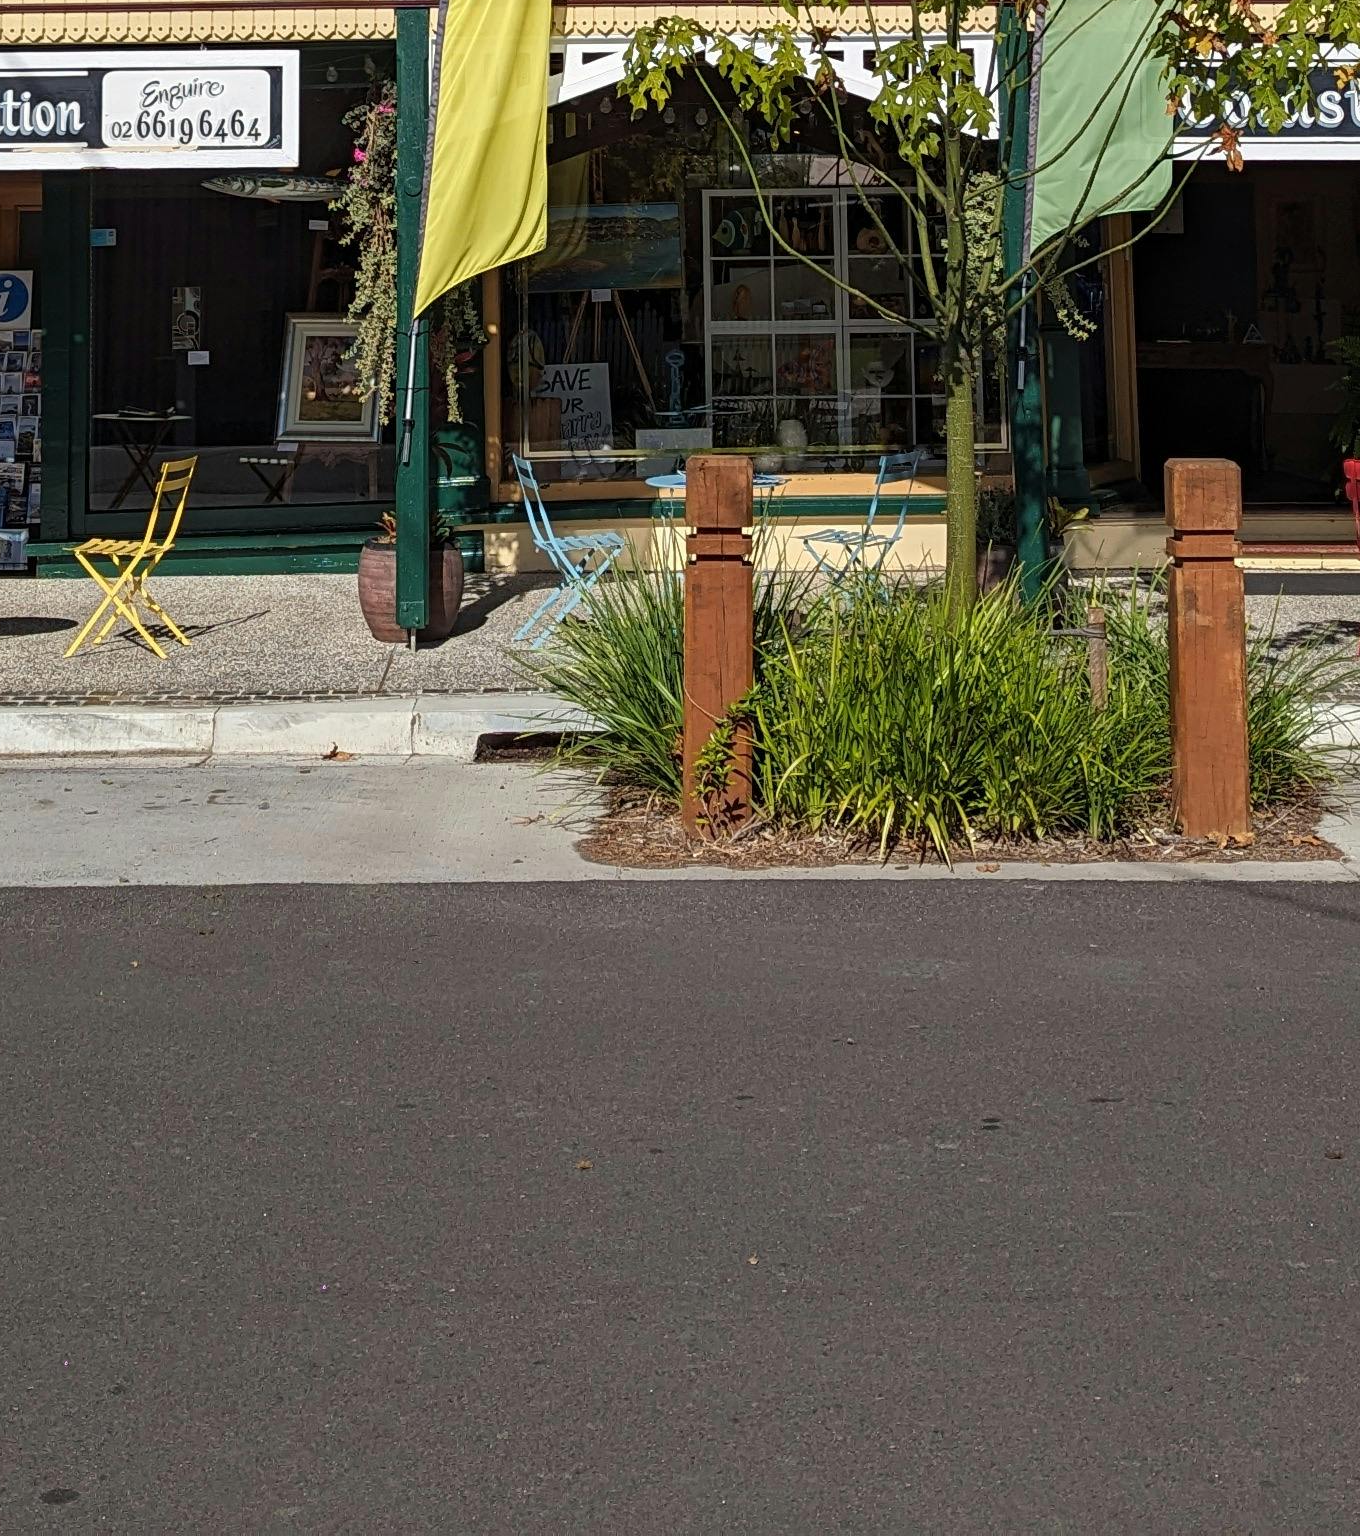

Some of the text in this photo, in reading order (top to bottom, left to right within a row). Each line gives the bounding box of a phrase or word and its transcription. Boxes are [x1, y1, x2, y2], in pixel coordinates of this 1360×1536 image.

[110, 120, 132, 139] 02
[199, 109, 262, 144] 6464
[560, 397, 585, 414] UR
